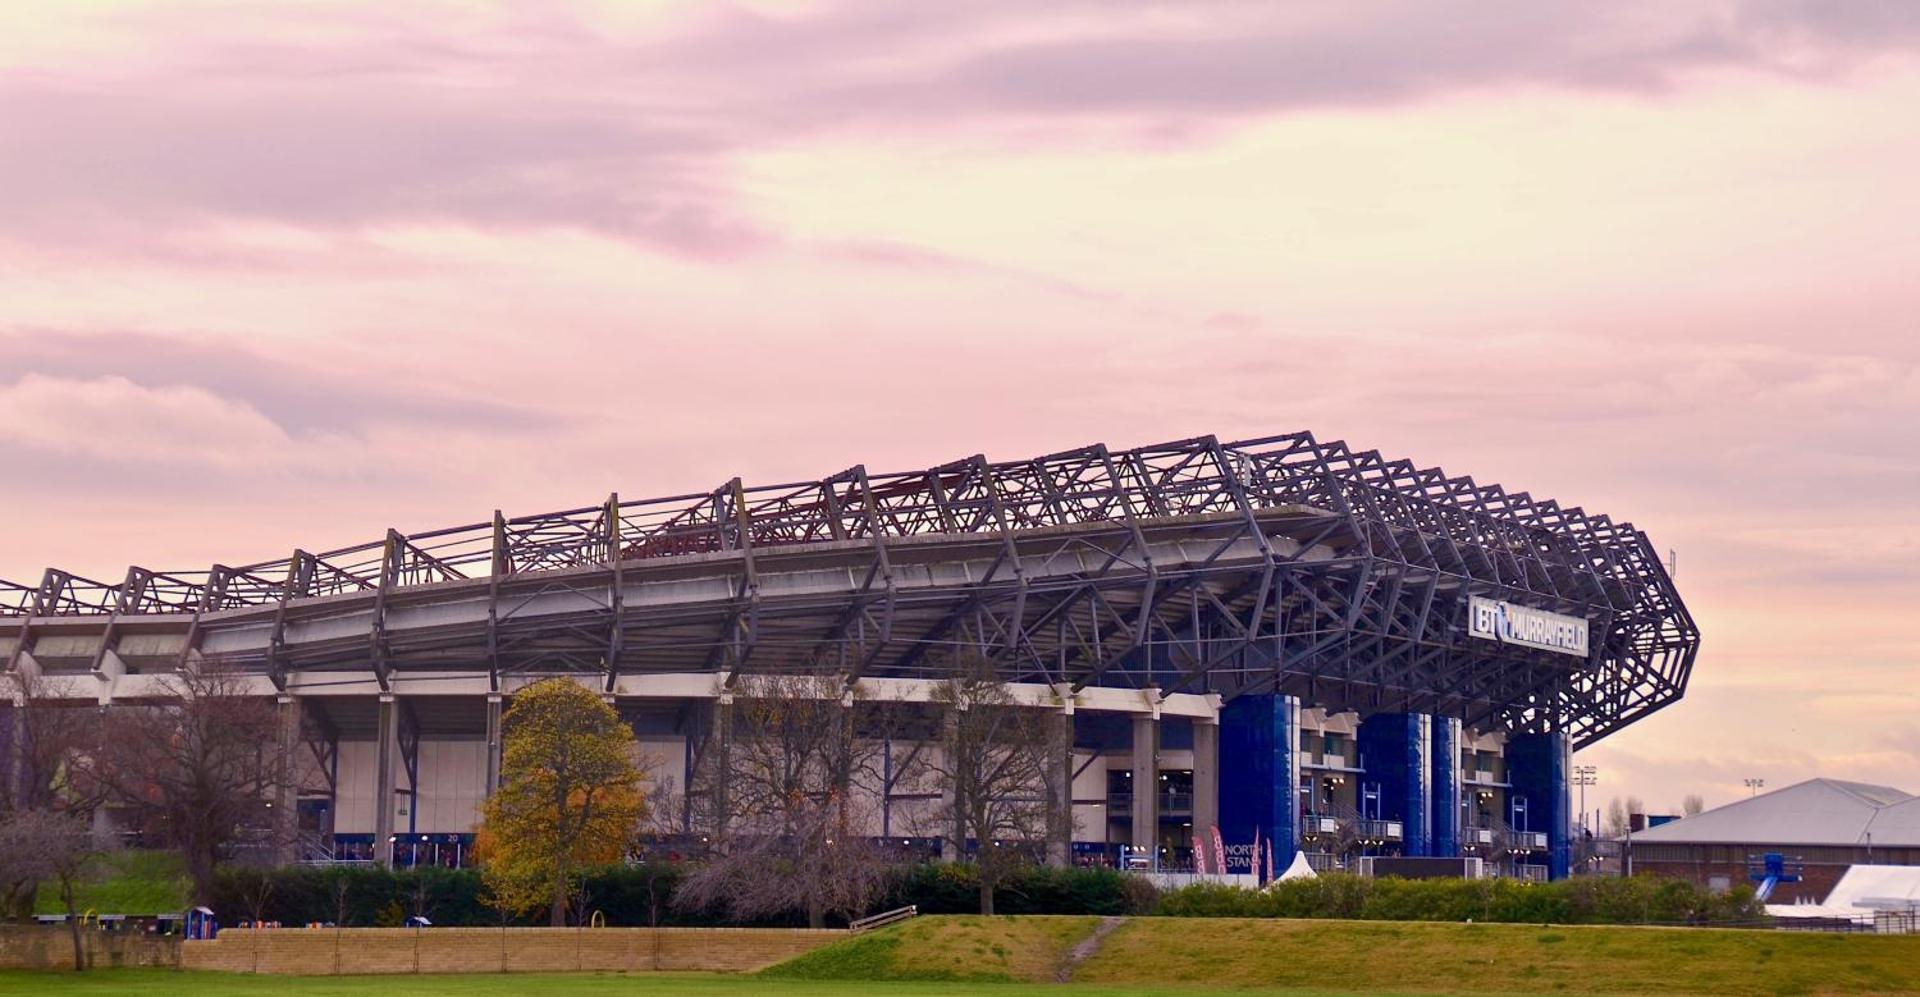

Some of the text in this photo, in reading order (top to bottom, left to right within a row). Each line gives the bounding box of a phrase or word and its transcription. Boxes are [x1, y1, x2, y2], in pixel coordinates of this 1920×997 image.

[1474, 605, 1585, 650] BT MURRAYFIELD
[1224, 844, 1263, 856] NORTH
